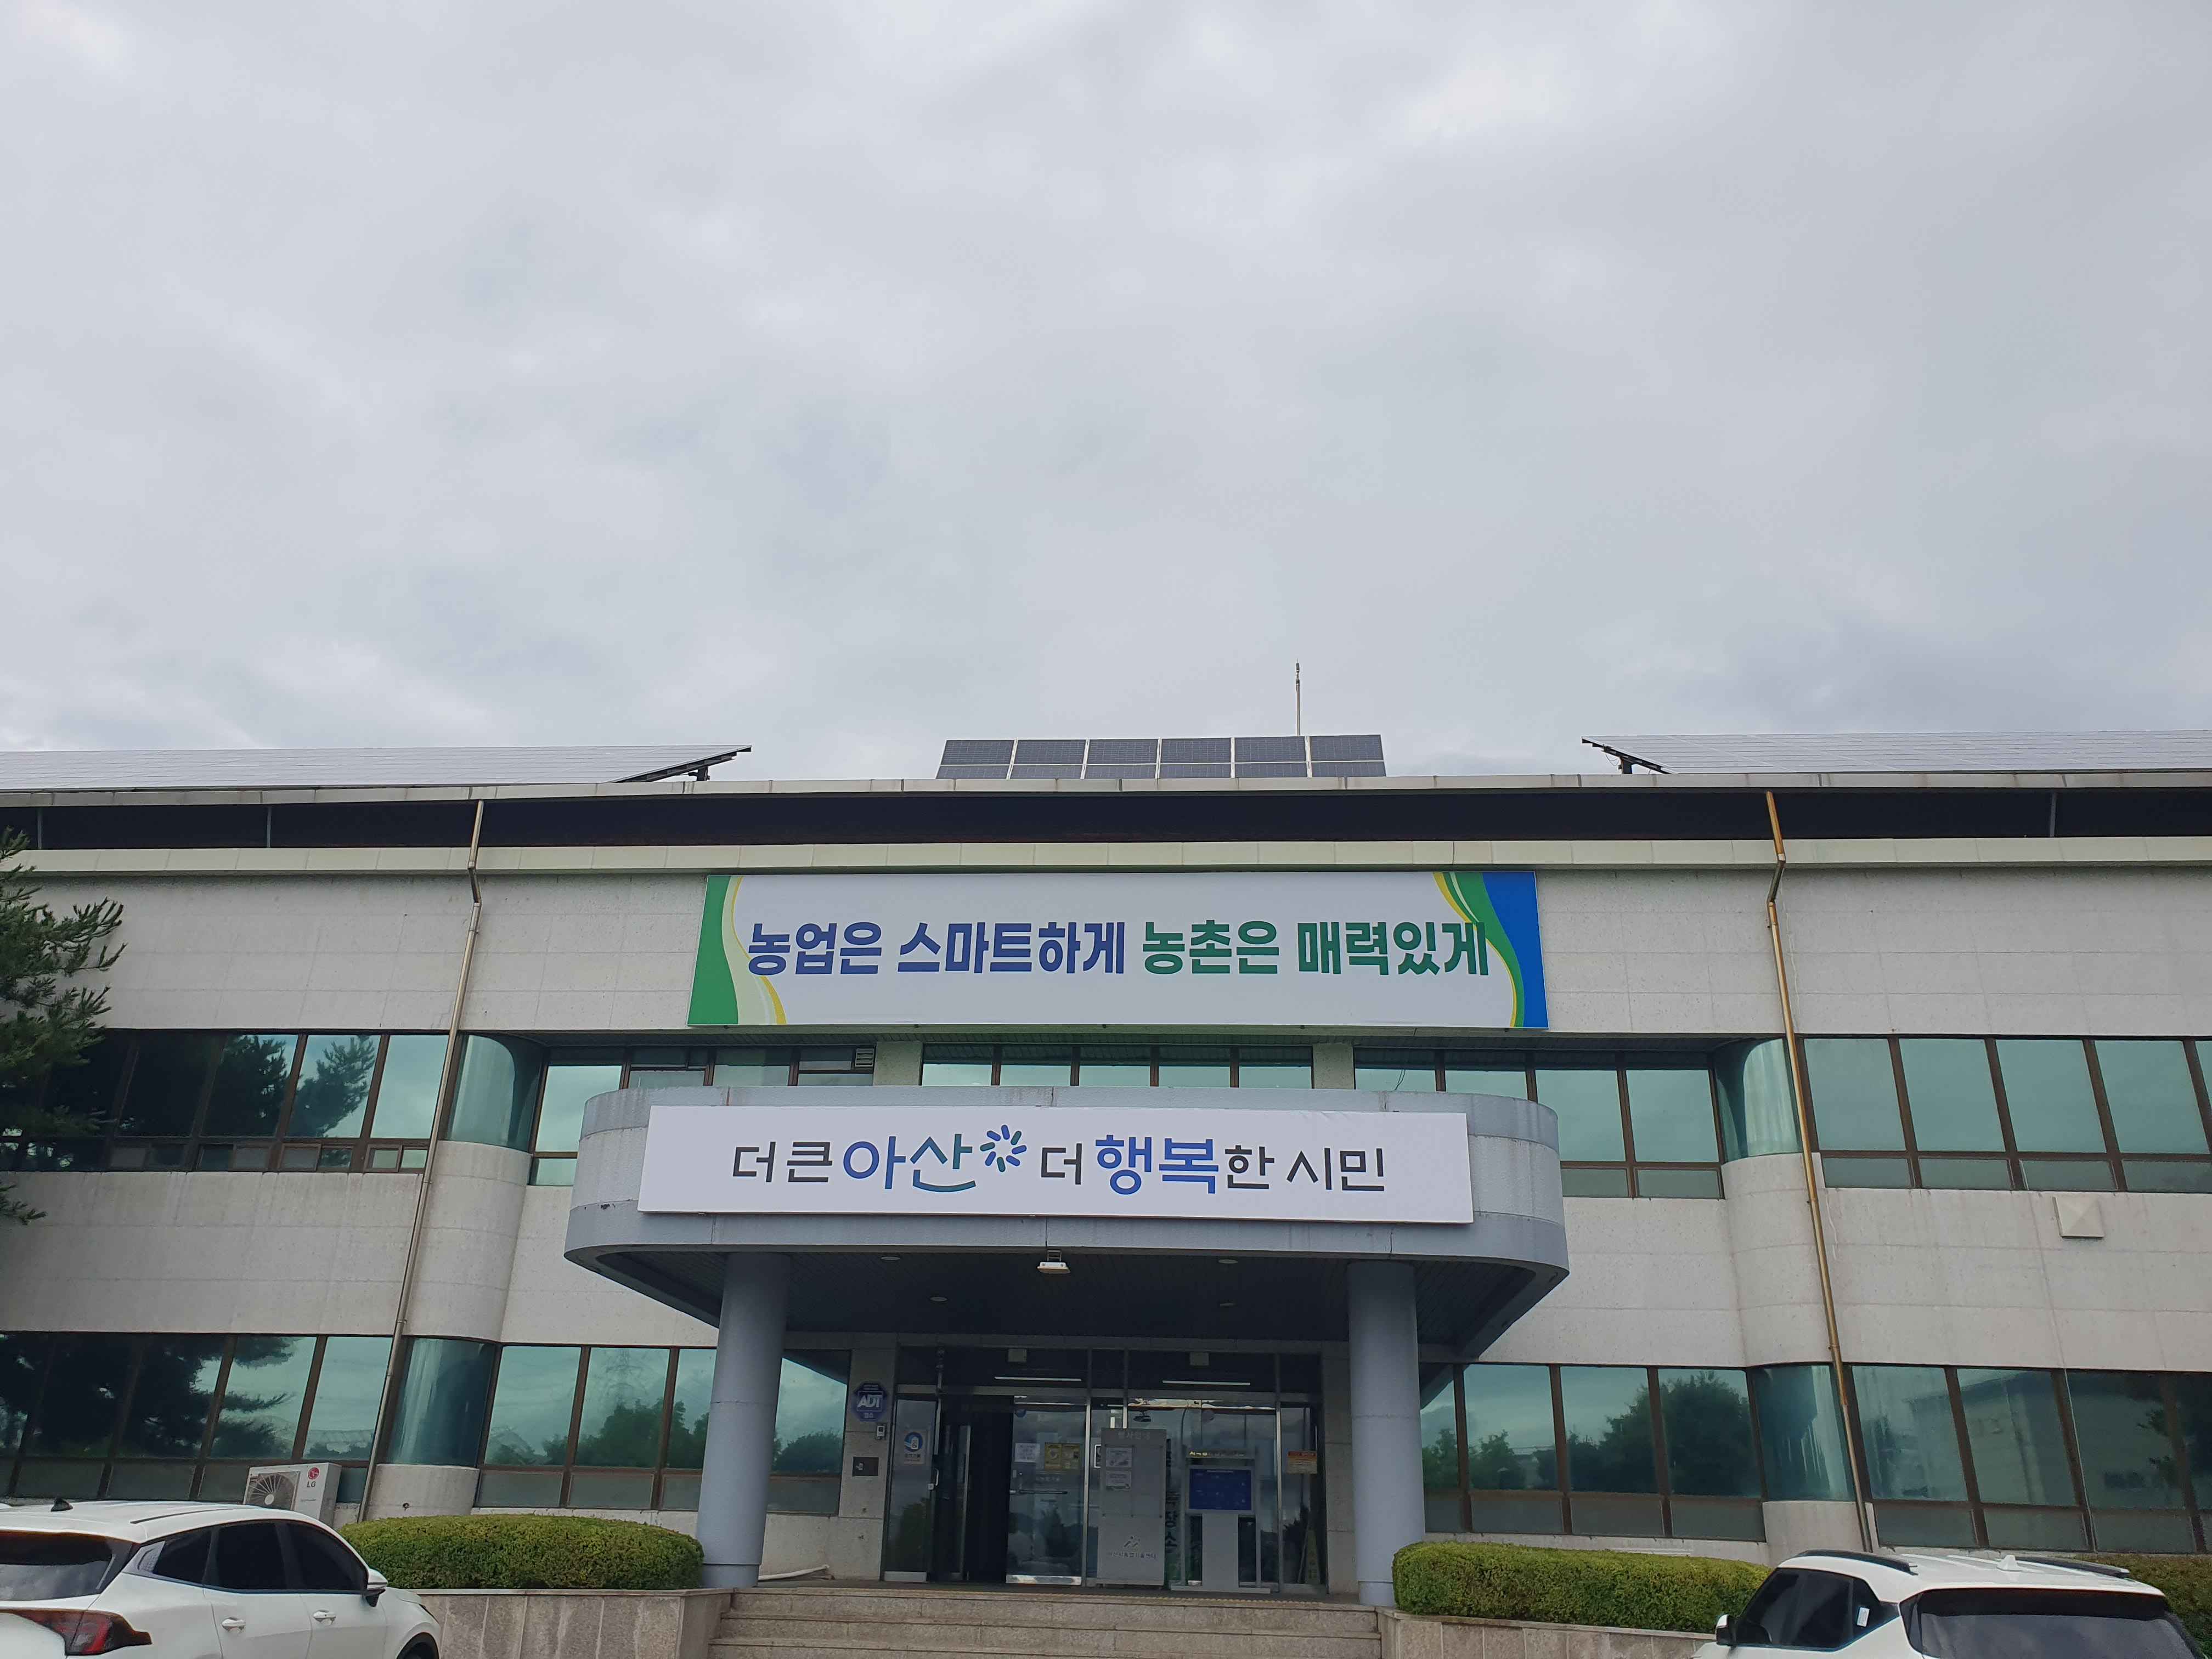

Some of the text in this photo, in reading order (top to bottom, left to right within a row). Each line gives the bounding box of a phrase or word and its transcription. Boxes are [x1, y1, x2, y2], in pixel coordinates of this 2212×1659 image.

[748, 919, 1488, 976] 농업은 스마트하게 농촌은 매력있게
[843, 1133, 977, 1193] 아산
[1041, 1143, 1082, 1185] 더
[1286, 1148, 1385, 1192] 시민
[857, 1394, 883, 1408] ADT
